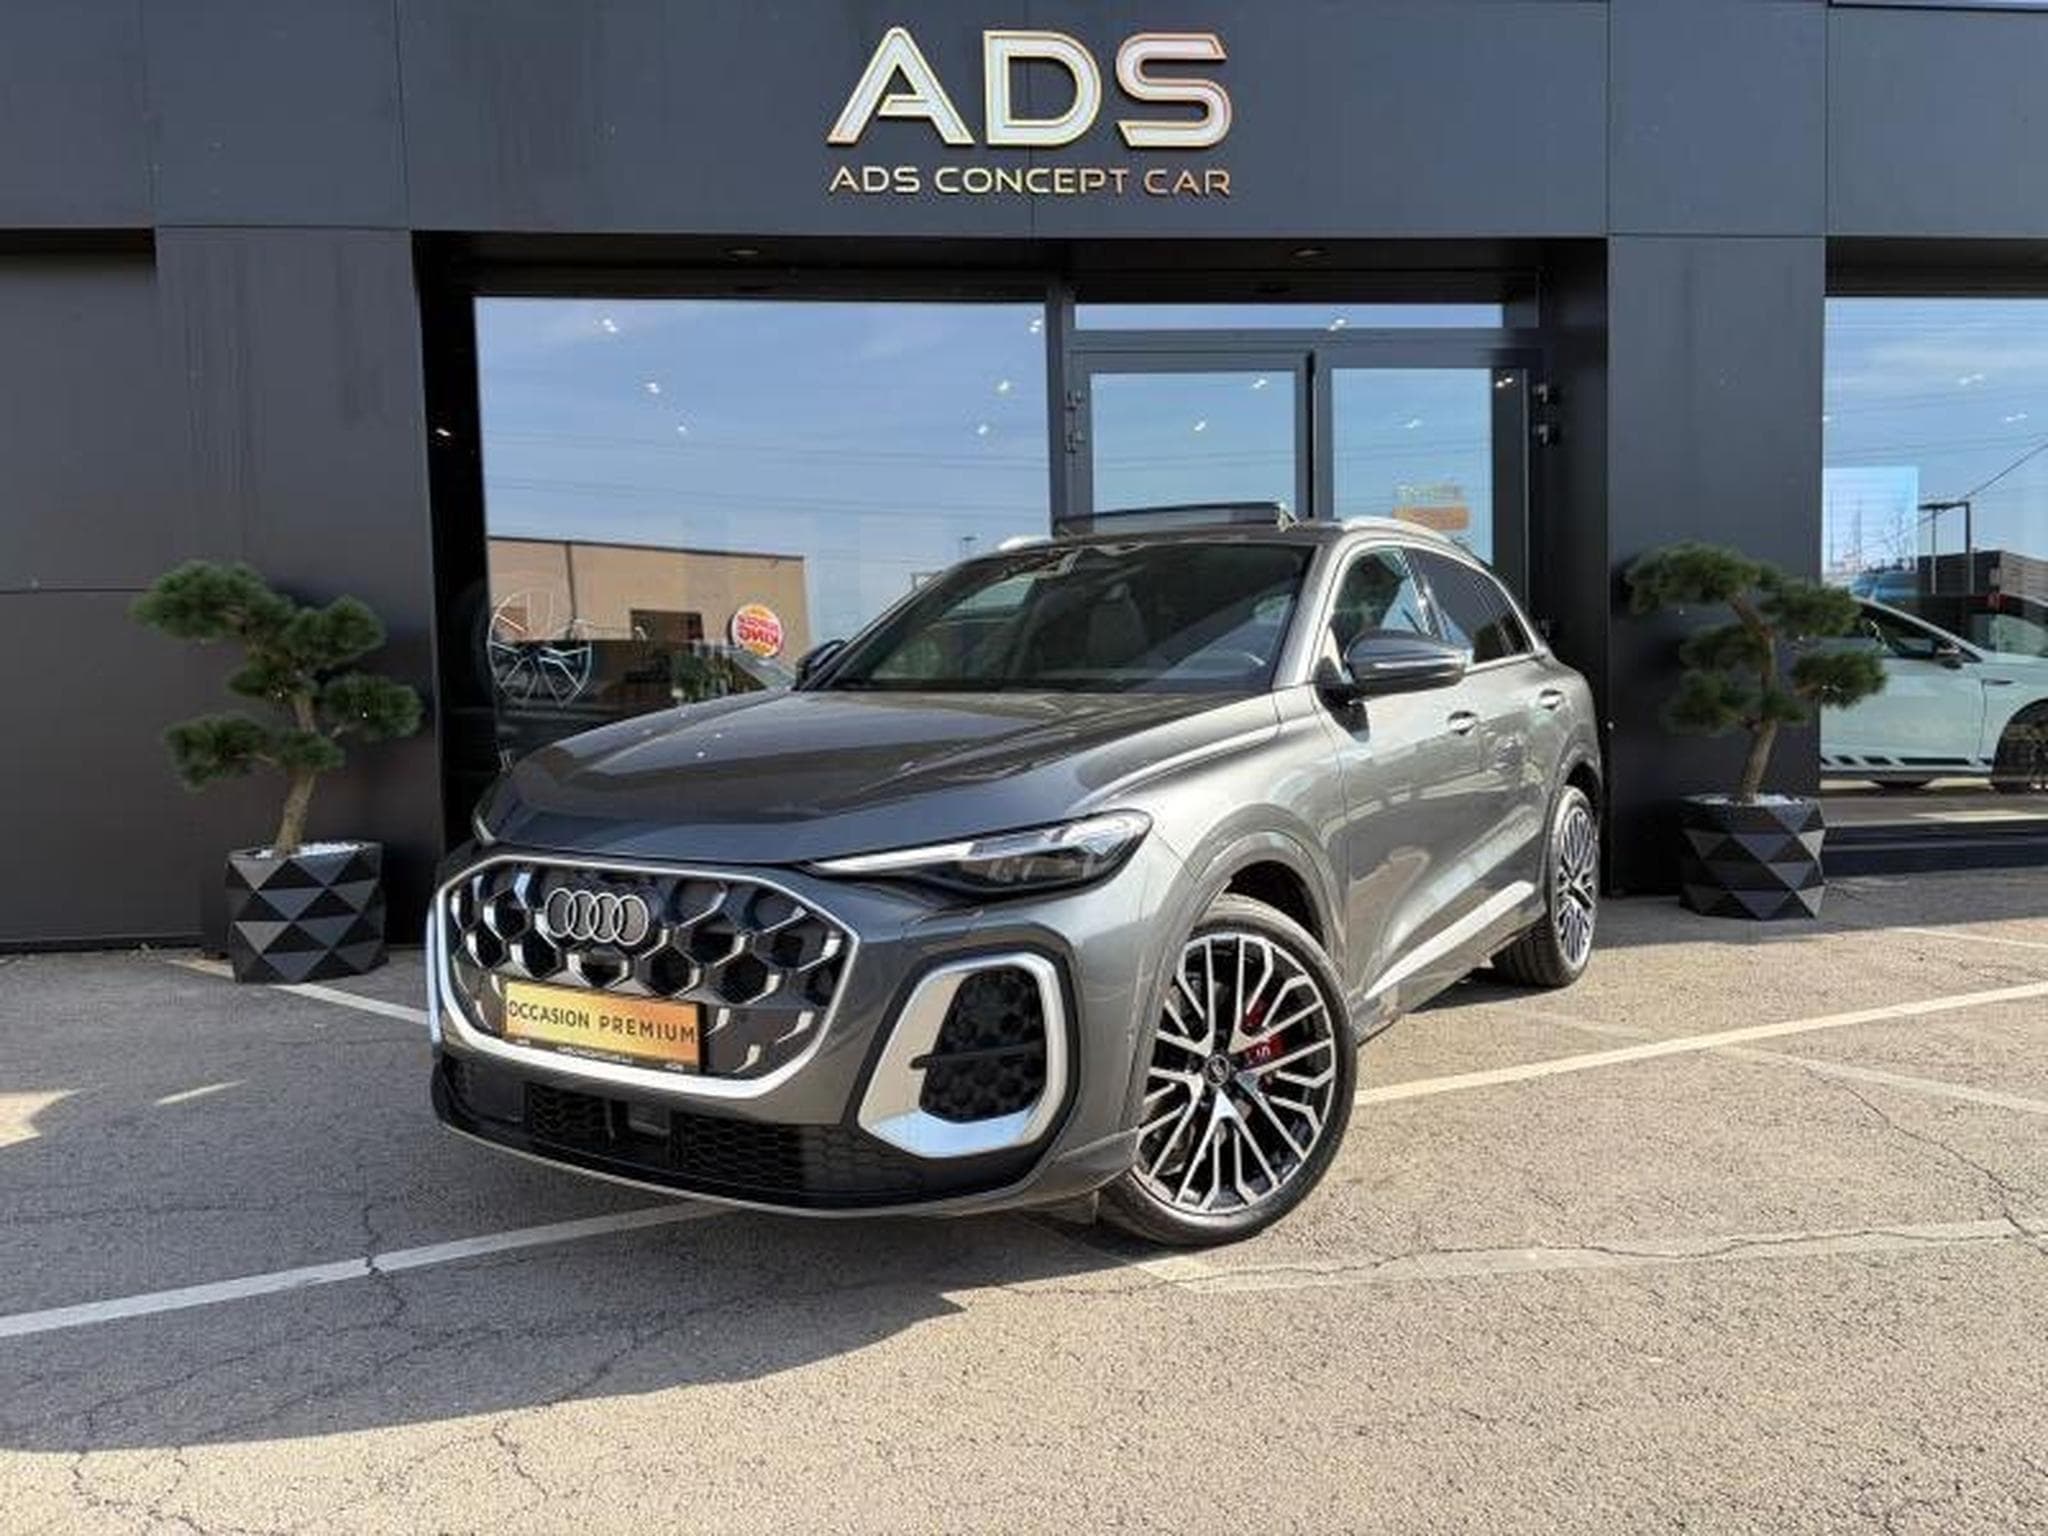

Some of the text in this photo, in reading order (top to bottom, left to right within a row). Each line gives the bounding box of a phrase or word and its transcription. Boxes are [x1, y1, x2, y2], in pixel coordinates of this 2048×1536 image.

[827, 27, 1232, 147] ADS
[829, 165, 1231, 195] ADS CONCEPT CAR
[508, 999, 695, 1044] OCCASION PREMIUM
